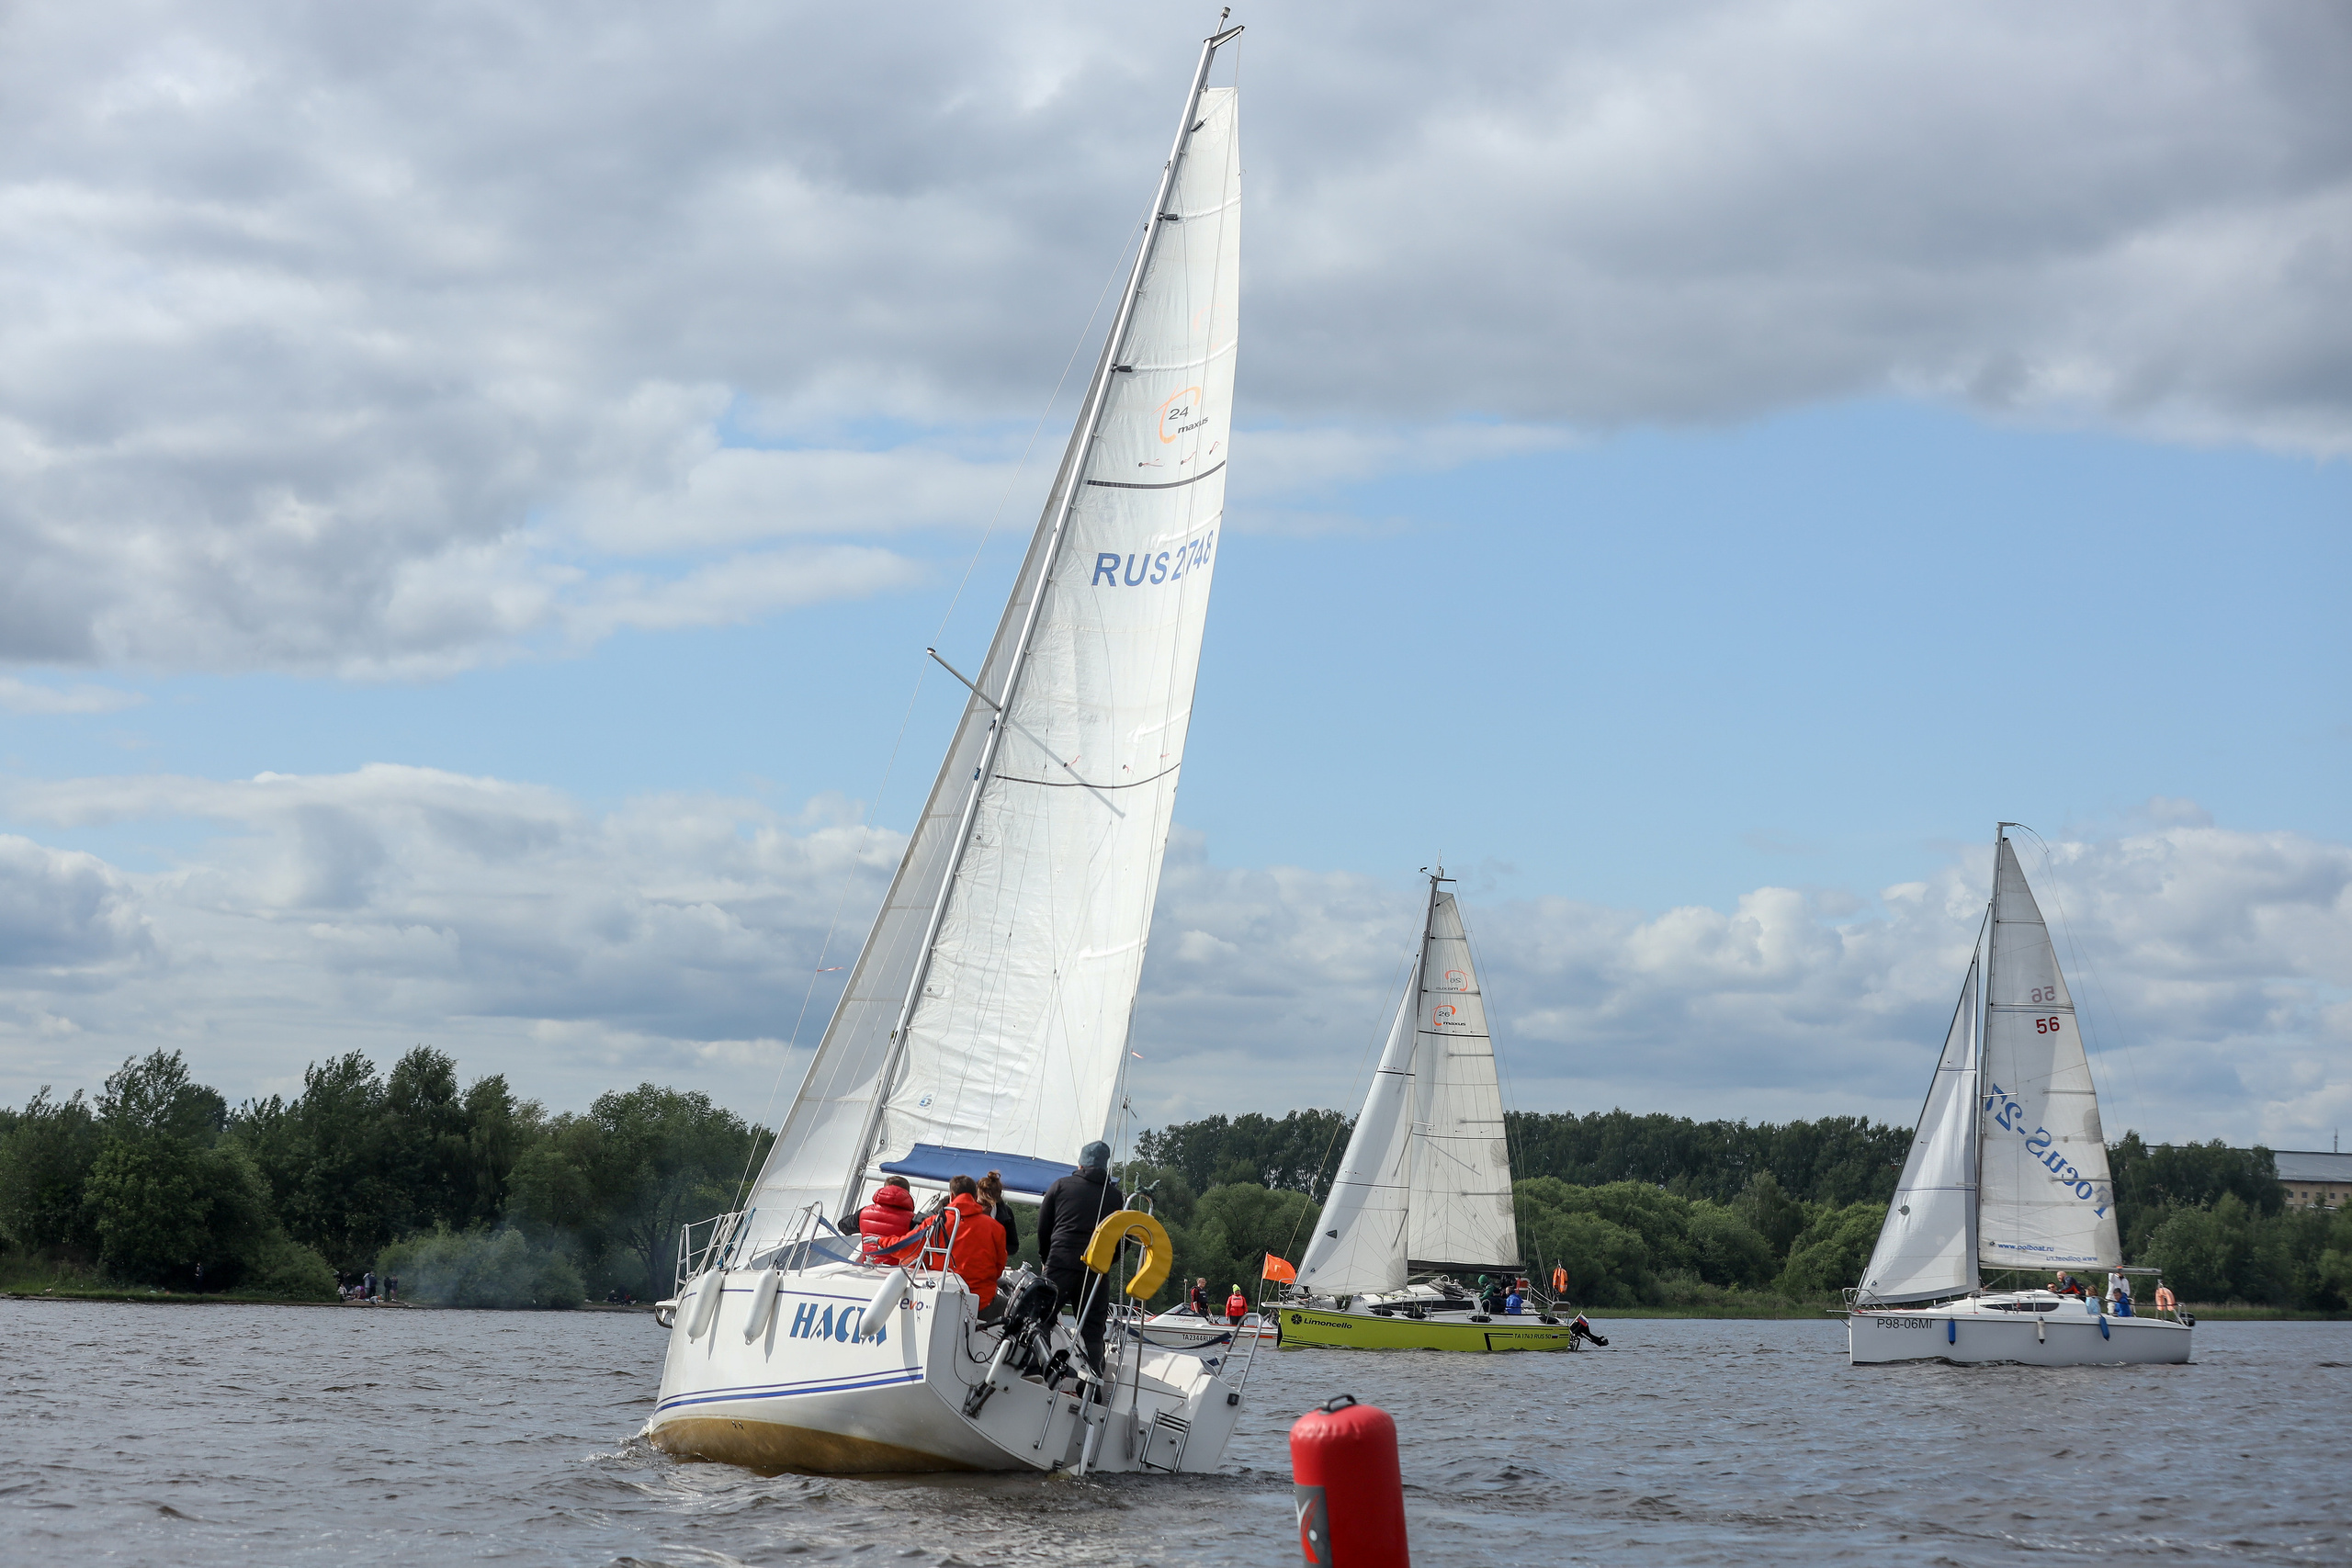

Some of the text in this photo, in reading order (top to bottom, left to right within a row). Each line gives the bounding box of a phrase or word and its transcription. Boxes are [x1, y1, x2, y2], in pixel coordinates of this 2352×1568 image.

[1169, 406, 1189, 421] 24
[1178, 416, 1208, 434] maxus
[2035, 1016, 2061, 1034] 56
[1997, 1242, 2054, 1252] www.polboat.ru
[899, 1297, 924, 1311] evo
[1304, 1317, 1353, 1329] Limoncello
